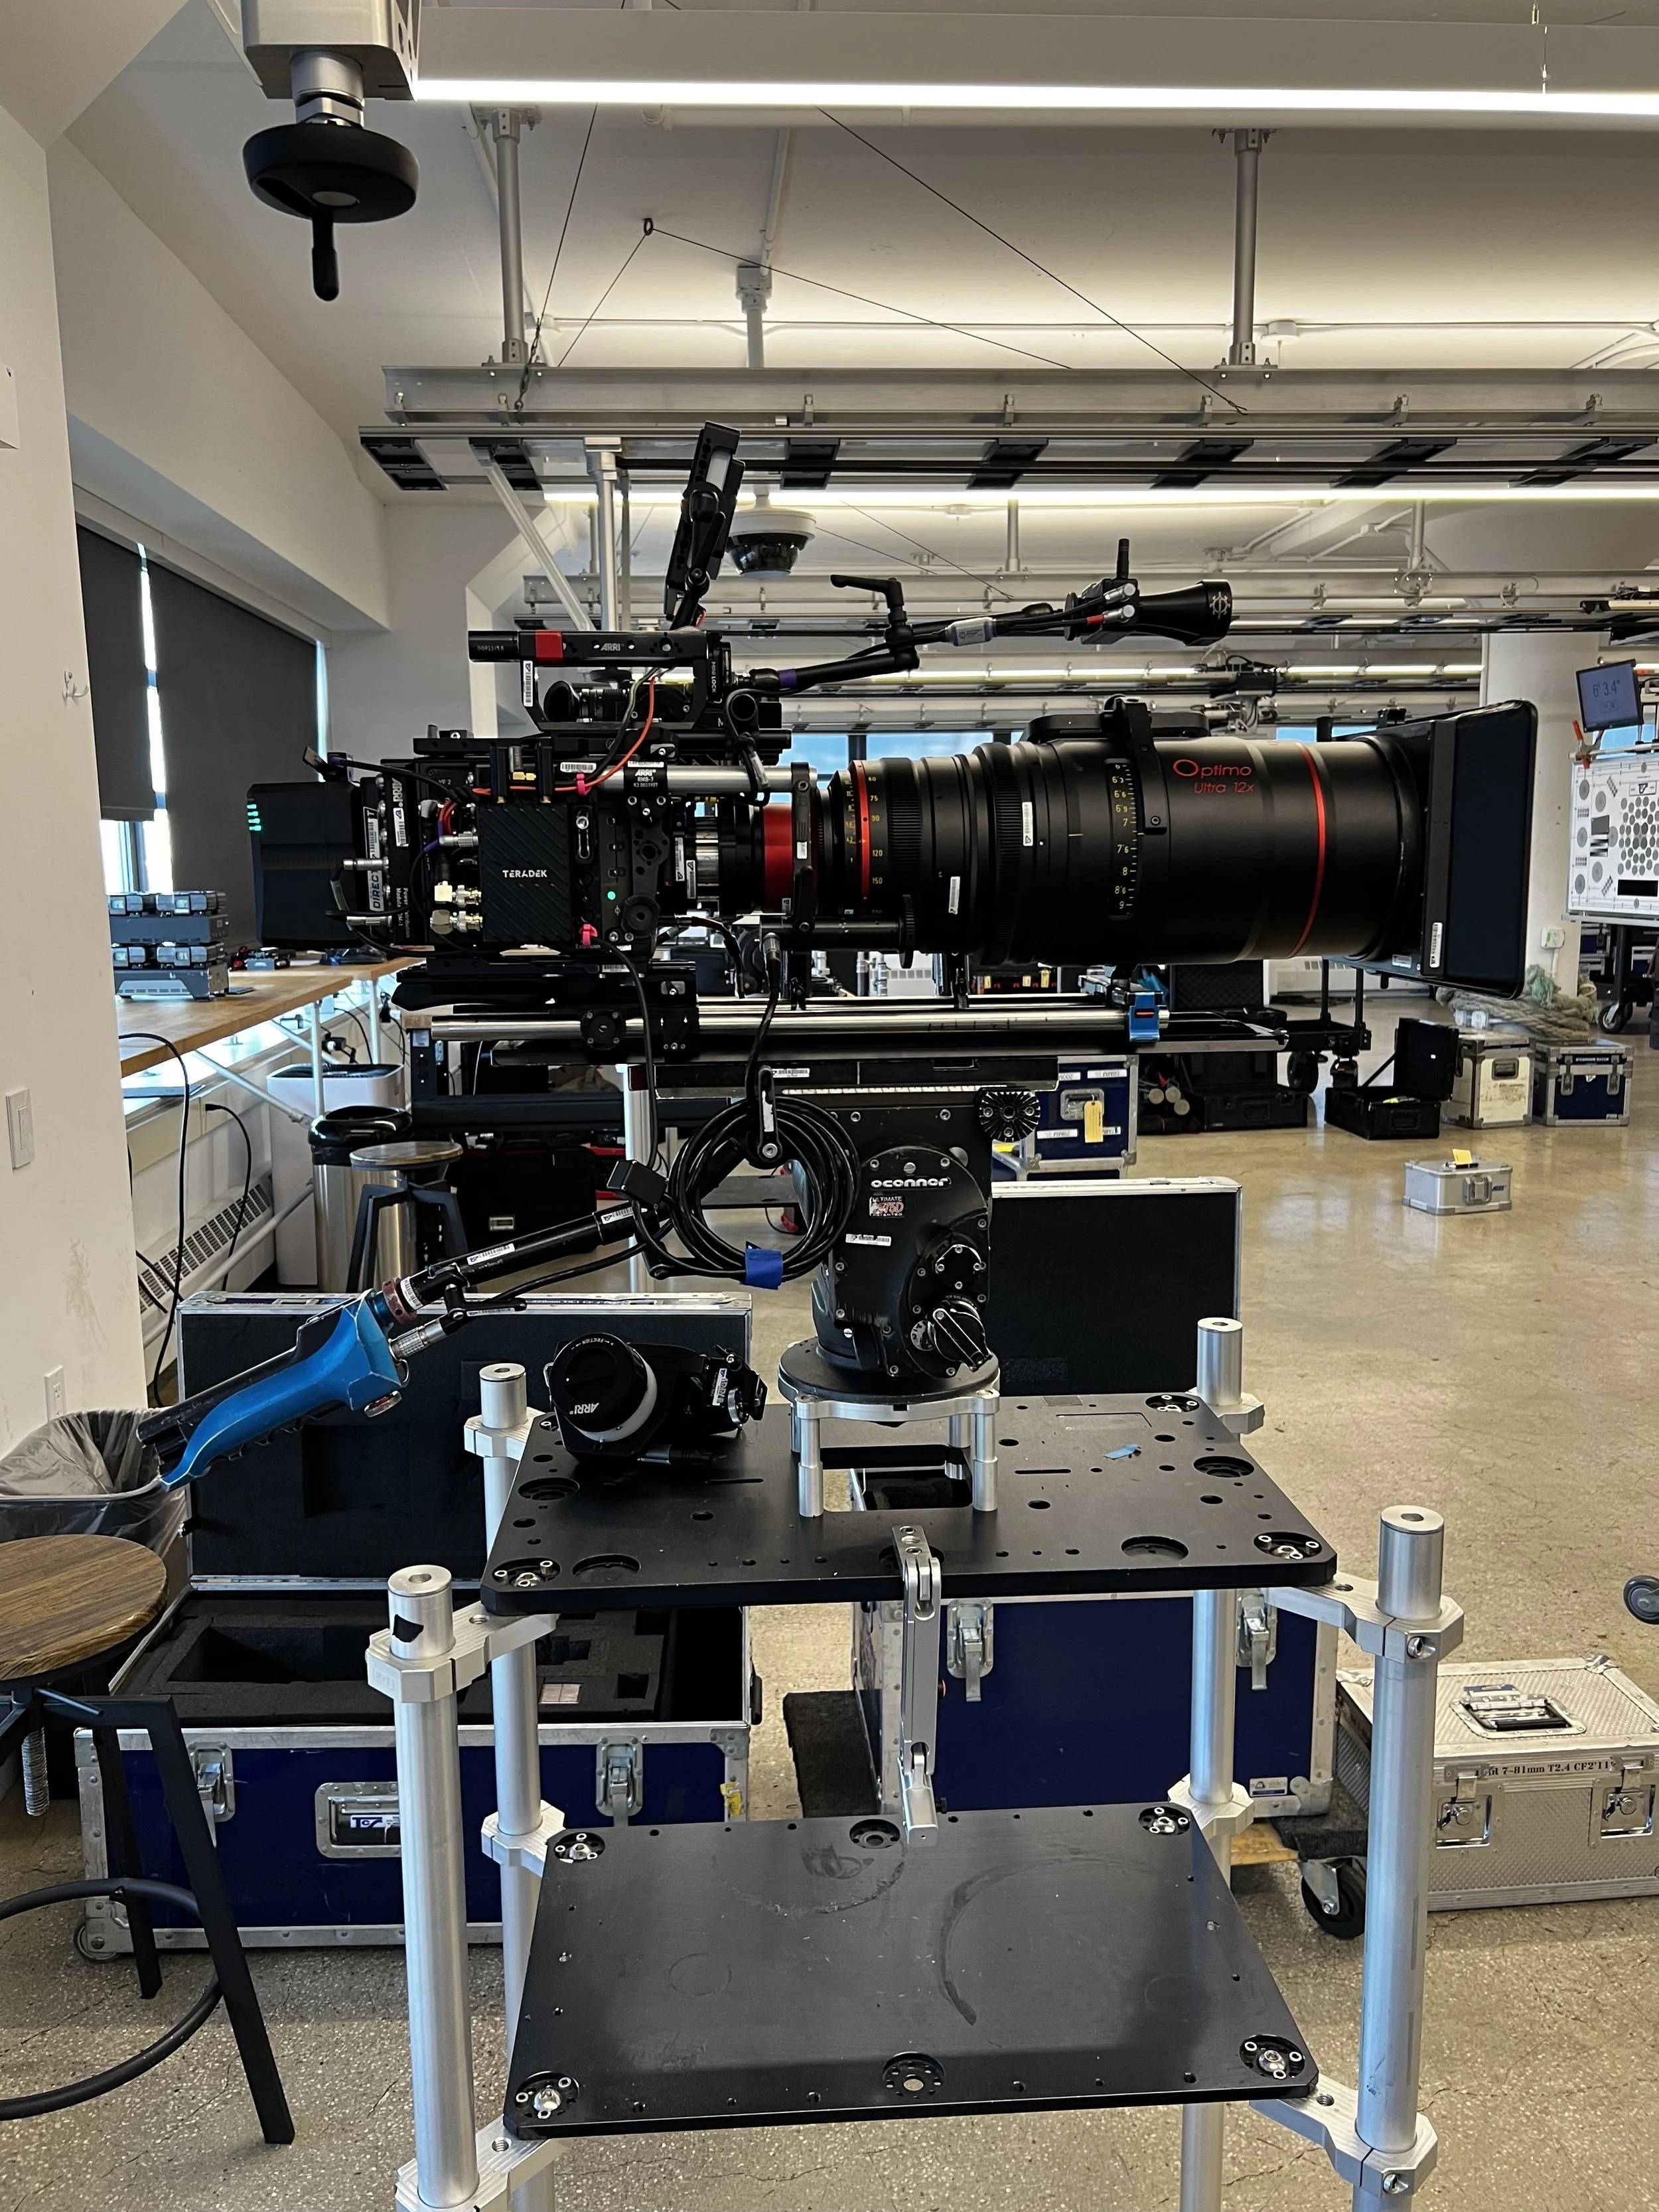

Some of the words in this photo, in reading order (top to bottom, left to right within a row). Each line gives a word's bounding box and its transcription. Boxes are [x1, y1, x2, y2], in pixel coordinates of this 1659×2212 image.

[1173, 759, 1252, 778] Optimo
[392, 778, 404, 802] ARRI
[1194, 782, 1226, 794] Ultra
[1234, 782, 1254, 793] 12x
[1122, 818, 1128, 827] 7
[502, 869, 547, 878] TERADEK
[1122, 867, 1128, 875] 8
[871, 1178, 949, 1188] oconnor
[573, 1402, 599, 1414] ARRI
[1502, 1765, 1546, 1775] 7-81mm
[1548, 1763, 1571, 1773] T2.4
